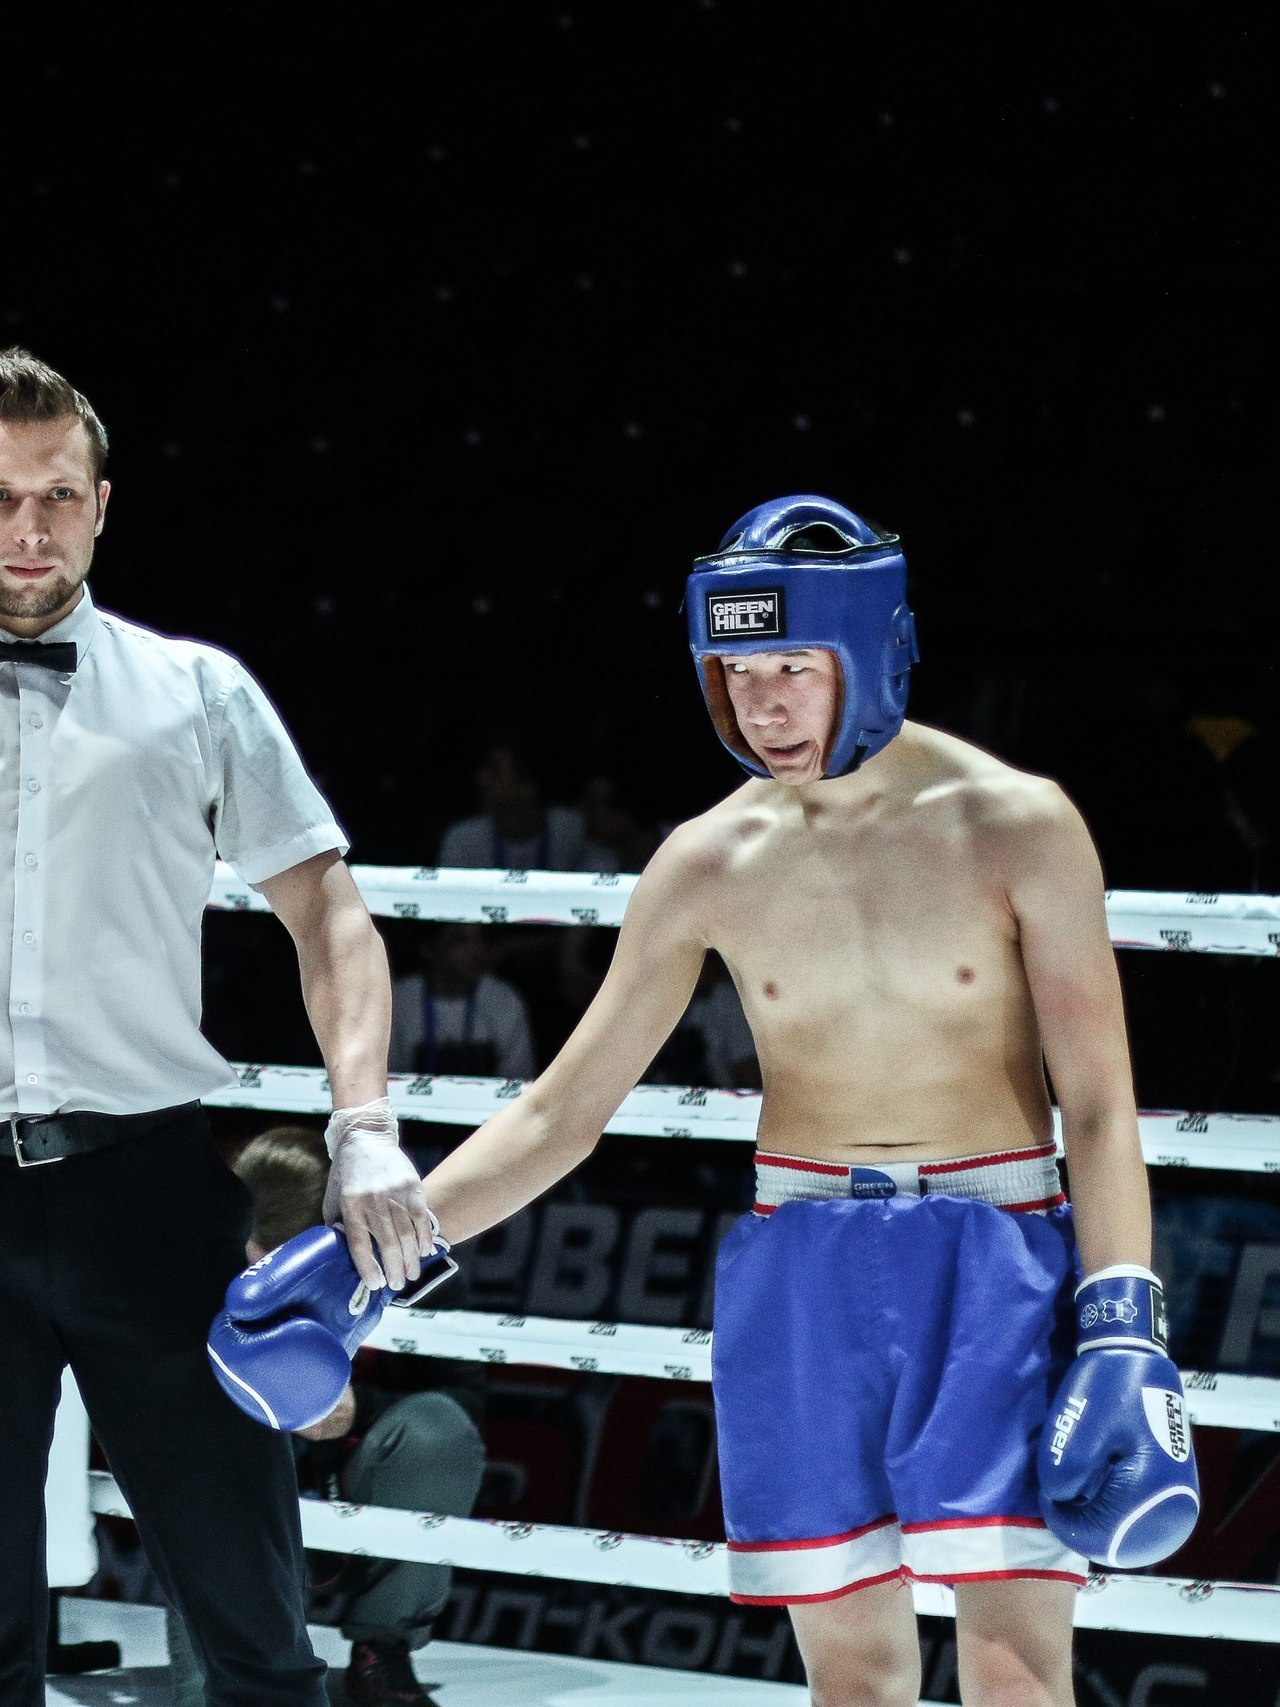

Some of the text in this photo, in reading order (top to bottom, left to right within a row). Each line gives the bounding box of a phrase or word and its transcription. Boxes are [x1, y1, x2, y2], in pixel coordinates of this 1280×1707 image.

[712, 600, 774, 616] GREEN
[714, 613, 765, 631] HILL
[853, 1182, 894, 1191] GREEN
[1050, 1396, 1088, 1466] Tiger
[1165, 1393, 1180, 1458] GREEN
